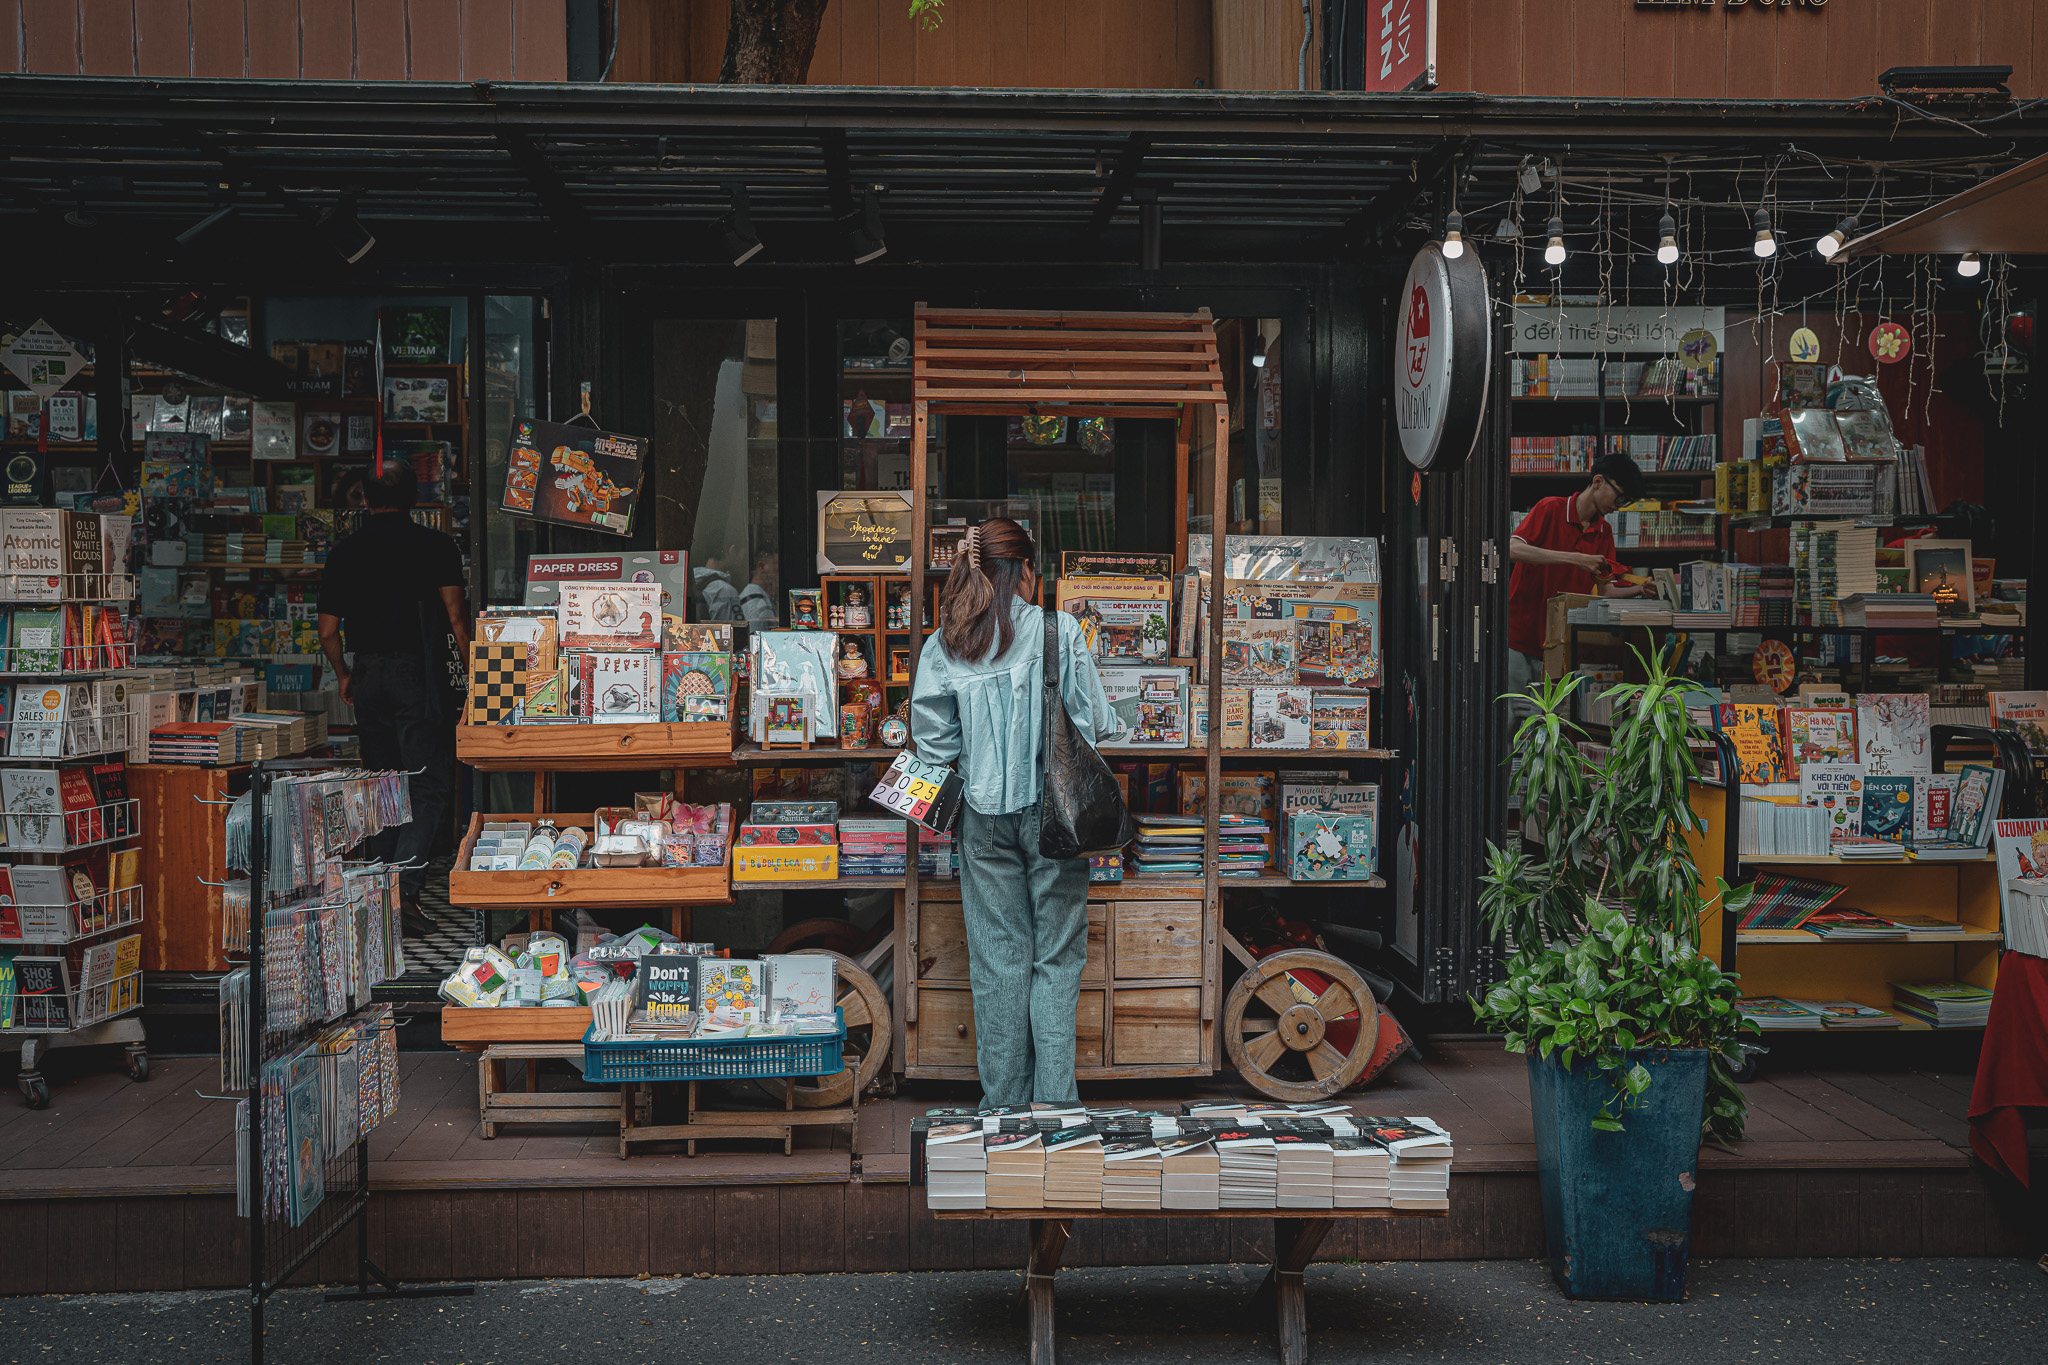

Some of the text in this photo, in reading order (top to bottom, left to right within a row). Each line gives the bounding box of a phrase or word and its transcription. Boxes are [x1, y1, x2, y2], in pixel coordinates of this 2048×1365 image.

[1569, 322, 1600, 340] thế
[1606, 322, 1640, 344] giới
[1643, 322, 1675, 340] lớn
[392, 346, 436, 355] VIETNAM
[286, 381, 331, 391] VITNAM
[1401, 383, 1432, 430] KIM ĐỒNG
[256, 415, 291, 426] Sapiens
[894, 471, 911, 486] TH
[76, 520, 96, 530] OLD
[77, 531, 97, 540] PATH
[114, 529, 125, 537] JOY
[4, 533, 61, 550] Atomic
[73, 541, 101, 551] WHITE
[73, 550, 101, 561] CLOUDS
[663, 553, 675, 562] 3+
[7, 554, 59, 570] Habits
[534, 562, 619, 573] PAPER DRESS
[275, 674, 304, 683] PLANET
[102, 704, 126, 715] BUDGETING
[18, 711, 59, 721] SALES 101
[895, 754, 946, 784] 2025
[108, 773, 122, 782] ART
[1811, 773, 1856, 782] KHÉO KHÔN
[62, 782, 73, 790] ART
[76, 778, 88, 786] WAR
[884, 770, 937, 801] 2025
[1817, 782, 1850, 791] VỚI TIỀN
[1881, 782, 1890, 791] CÓ
[106, 790, 123, 798] WAR
[1294, 787, 1324, 796] Musical
[67, 793, 92, 803] WOMEN
[873, 785, 927, 816] 2025
[1329, 791, 1376, 805] PUZZLE
[1933, 795, 1945, 803] HỌC
[779, 815, 810, 823] Painting
[1998, 821, 2039, 838] UZUMAKI
[122, 941, 136, 951] SIDE
[117, 948, 139, 962] HUSTLE
[90, 960, 114, 973] STARTUP
[22, 967, 53, 980] SHOE
[649, 967, 690, 980] Don't
[26, 979, 53, 990] DOG
[661, 992, 676, 1003] be
[26, 1007, 65, 1019] KNIGHT
